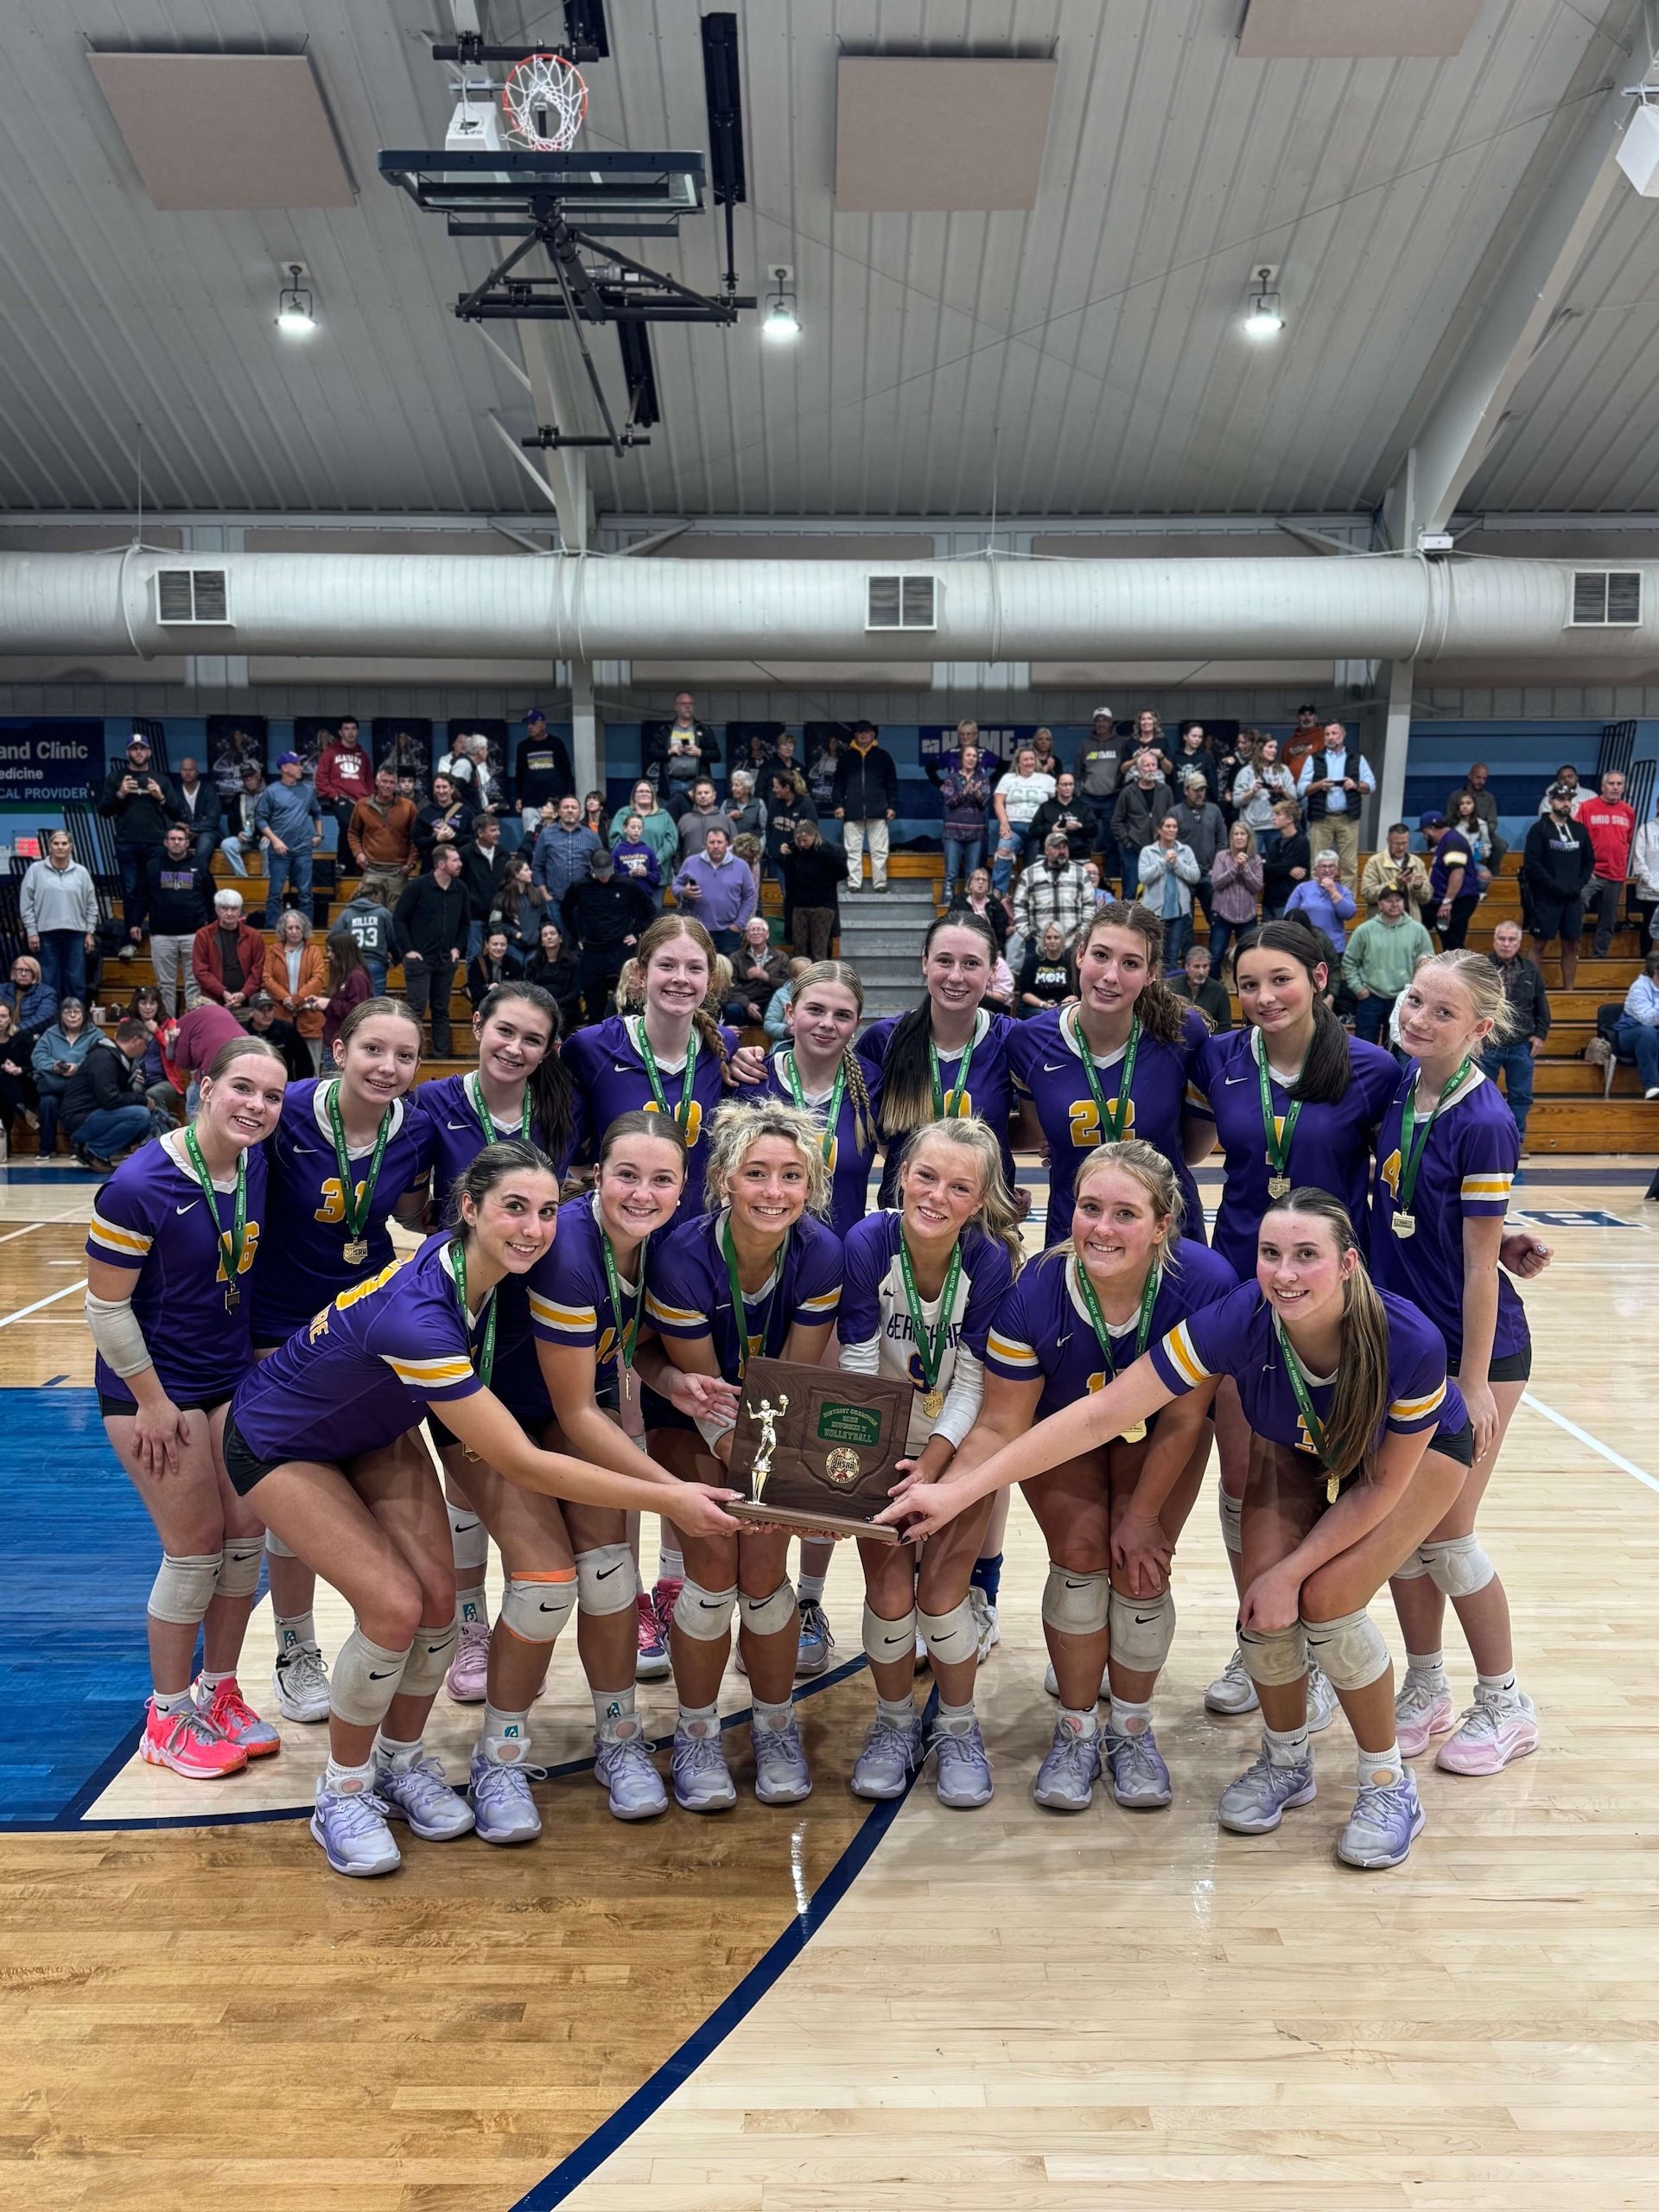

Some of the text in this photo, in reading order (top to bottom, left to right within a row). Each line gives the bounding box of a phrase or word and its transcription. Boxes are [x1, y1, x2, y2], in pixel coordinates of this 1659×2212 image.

[36, 741, 88, 760] Clinic
[0, 767, 43, 779] edicine
[25, 788, 87, 798] PROVIDER
[1591, 815, 1630, 827] OHIO STATE
[352, 916, 378, 927] MILLER
[351, 927, 378, 948] 33
[1035, 972, 1066, 984] MOM
[1069, 1097, 1136, 1147] 22
[824, 1428, 872, 1443] VOLLEYBALL
[831, 1458, 855, 1471] OHSAA
